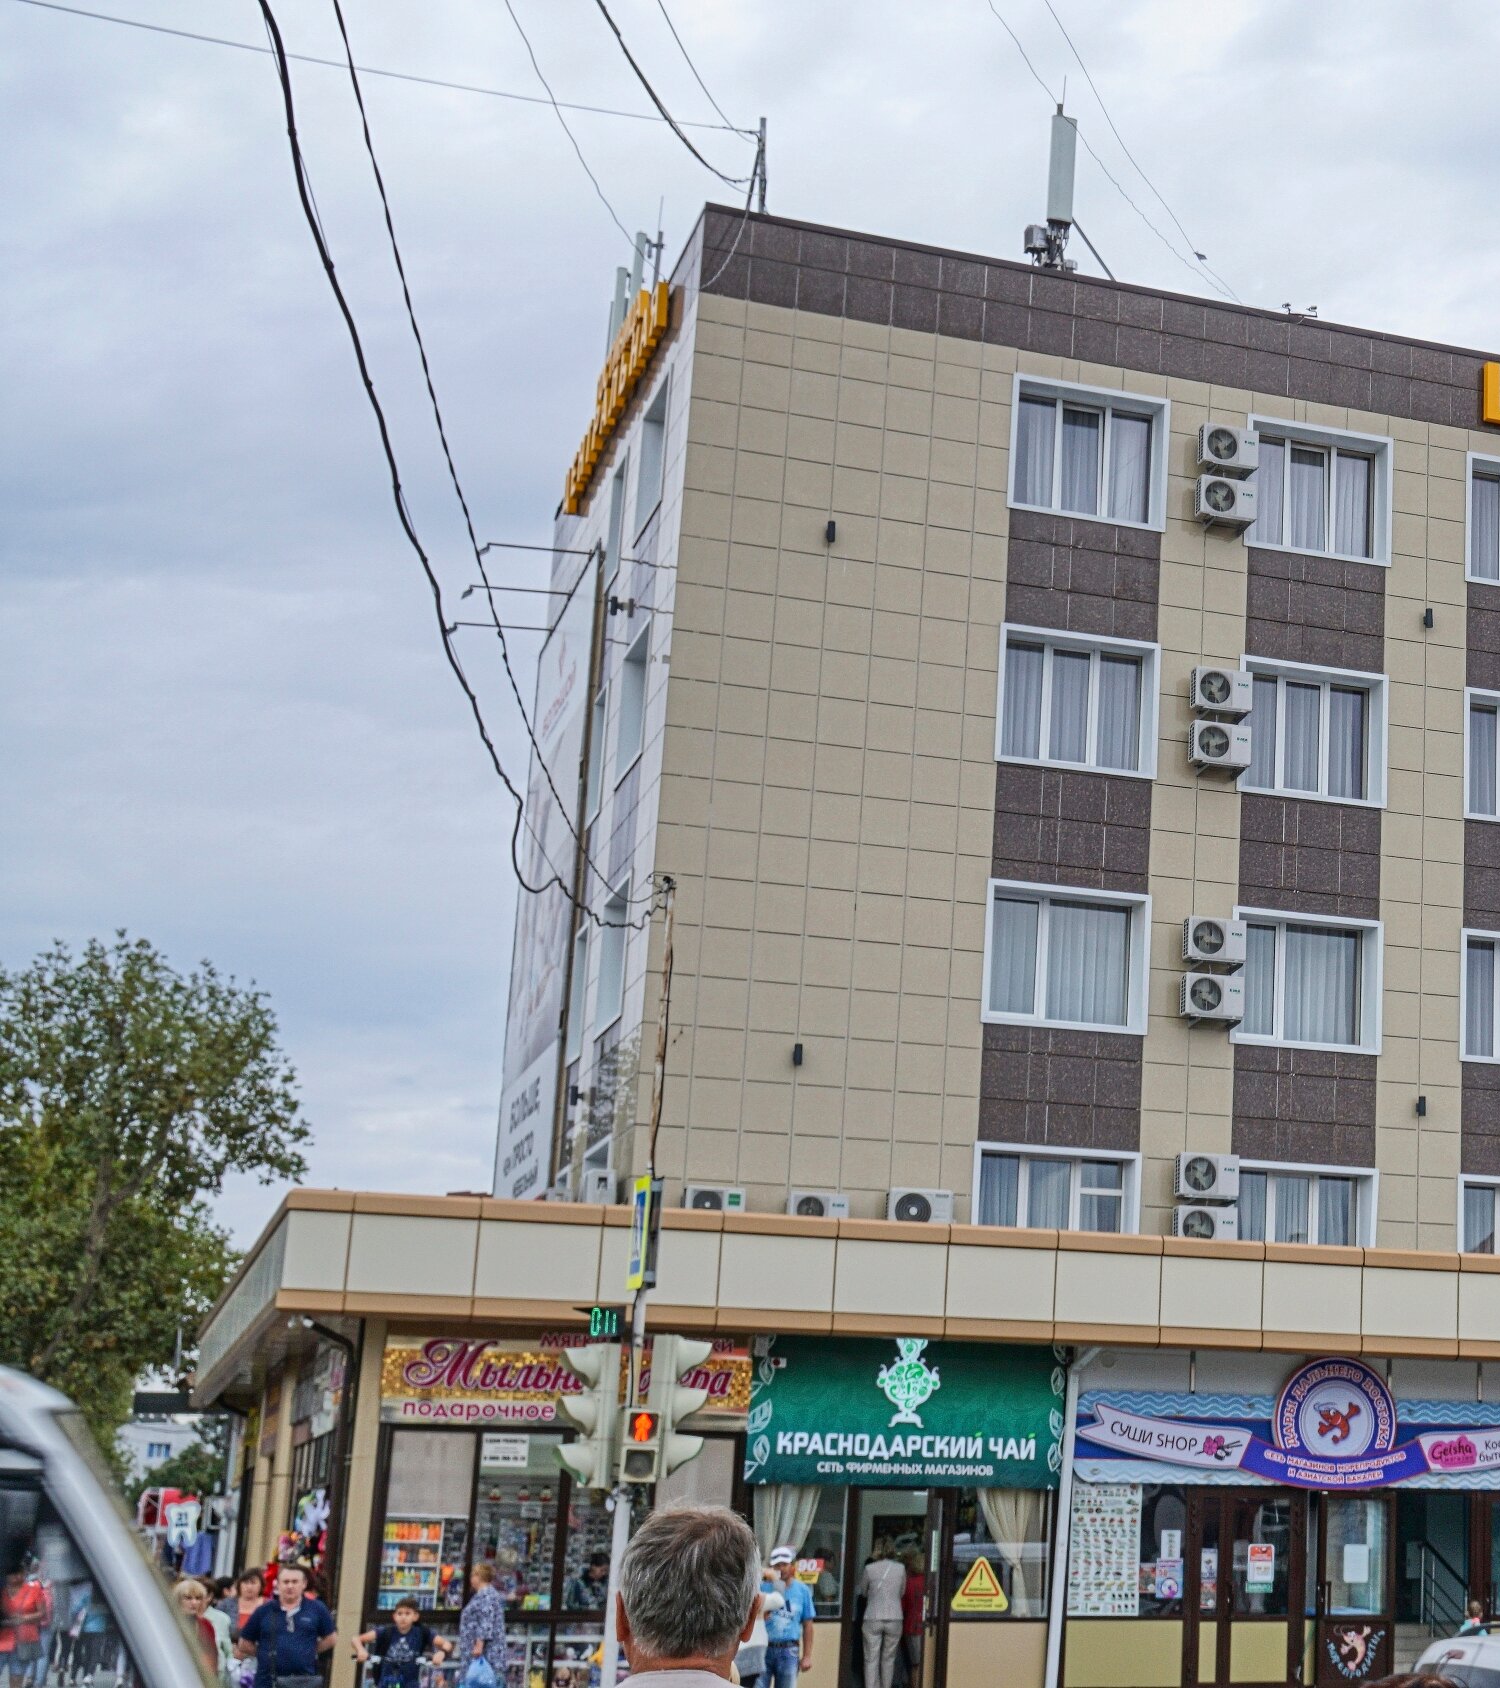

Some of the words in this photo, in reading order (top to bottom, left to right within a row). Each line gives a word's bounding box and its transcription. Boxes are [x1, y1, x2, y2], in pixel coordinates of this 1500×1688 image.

[403, 1339, 585, 1394] Мыльн
[1291, 1363, 1364, 1402] ДАЛЬНЕГО
[402, 1400, 556, 1421] подарочное
[1283, 1399, 1300, 1449] ДАРЫ
[1361, 1376, 1391, 1449] ВОСТОКА
[776, 1432, 983, 1461] КРАСНОДАРСКИЙ
[988, 1433, 1036, 1461] ЧАЙ
[1110, 1420, 1154, 1446] СУШИ
[1155, 1433, 1198, 1452] SHOP
[1431, 1439, 1473, 1461] Geisha
[816, 1461, 844, 1474] СЕТЬ
[845, 1462, 923, 1476] ФИРМЕННЫХ
[924, 1464, 994, 1477] МАГАЗИНОВ
[1263, 1448, 1287, 1464] СЕТЬ
[1287, 1455, 1336, 1473] МАГАЗИНОВ
[1336, 1450, 1407, 1473] МОРЕПРОДУКТОВ
[1287, 1467, 1296, 1477] И
[1296, 1469, 1345, 1485] АЗИАТСКОЙ
